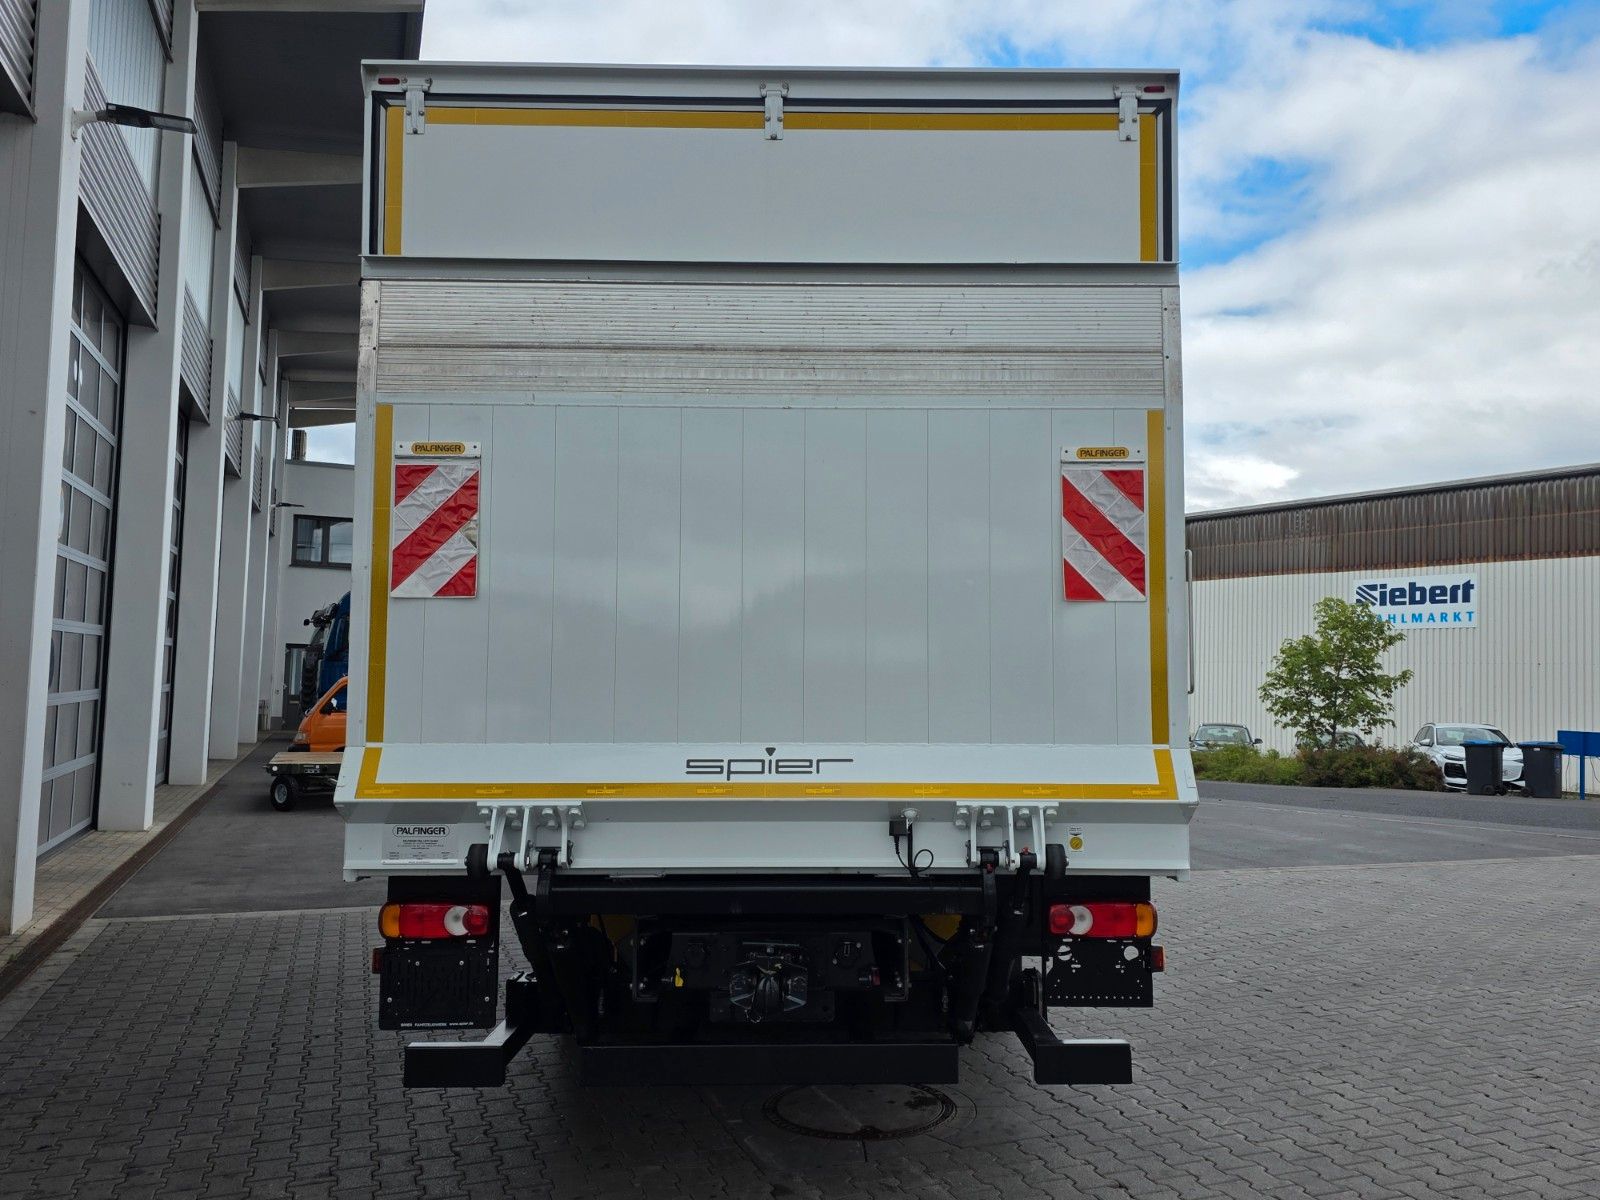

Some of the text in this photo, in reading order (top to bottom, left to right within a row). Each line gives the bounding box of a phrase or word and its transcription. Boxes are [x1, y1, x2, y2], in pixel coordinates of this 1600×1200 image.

[414, 444, 461, 452] PALFINGER
[1080, 449, 1126, 457] PALFINGER
[1355, 579, 1475, 607] Siebert
[685, 747, 854, 781] spier
[396, 826, 446, 835] PALFINGER
